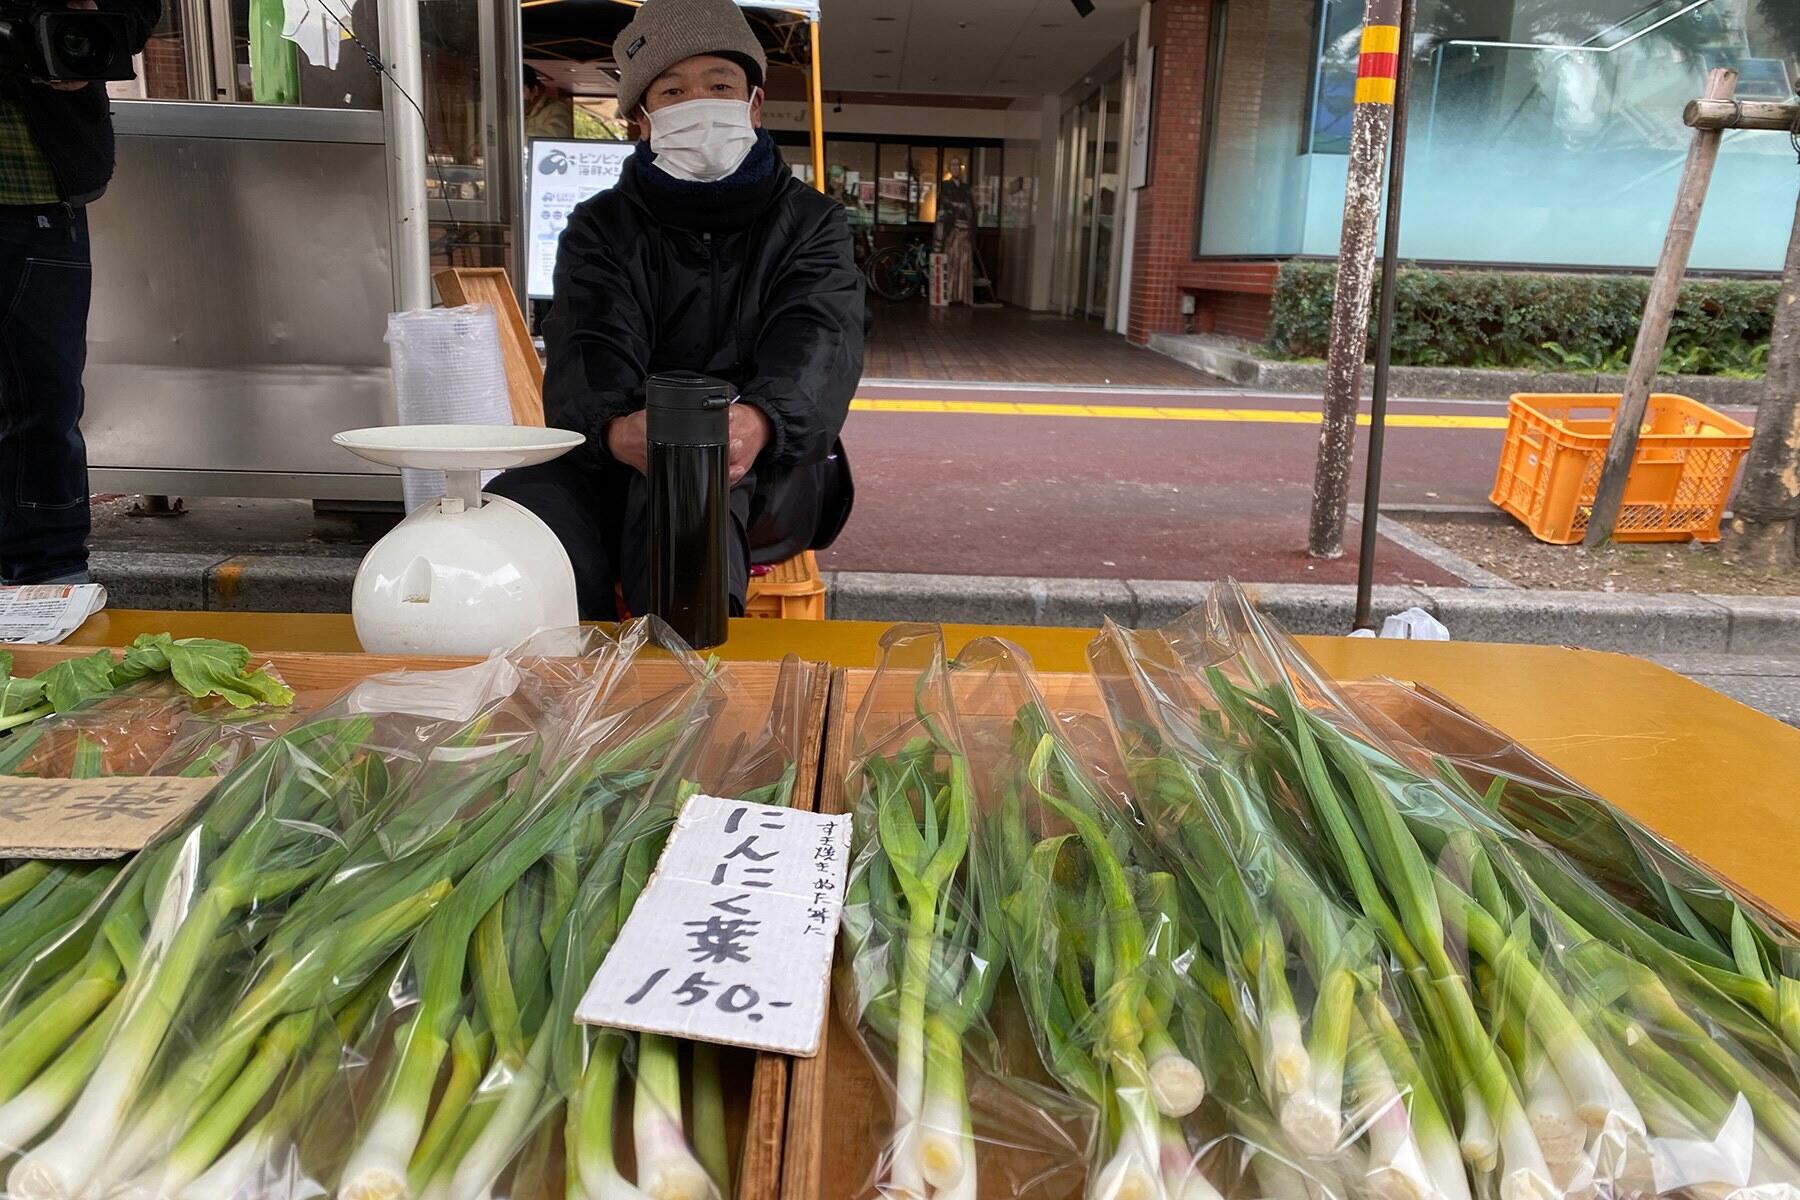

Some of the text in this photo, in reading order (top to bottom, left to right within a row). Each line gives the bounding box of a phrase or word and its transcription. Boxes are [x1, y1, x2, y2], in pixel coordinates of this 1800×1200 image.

[683, 807, 786, 963] にんにく葉
